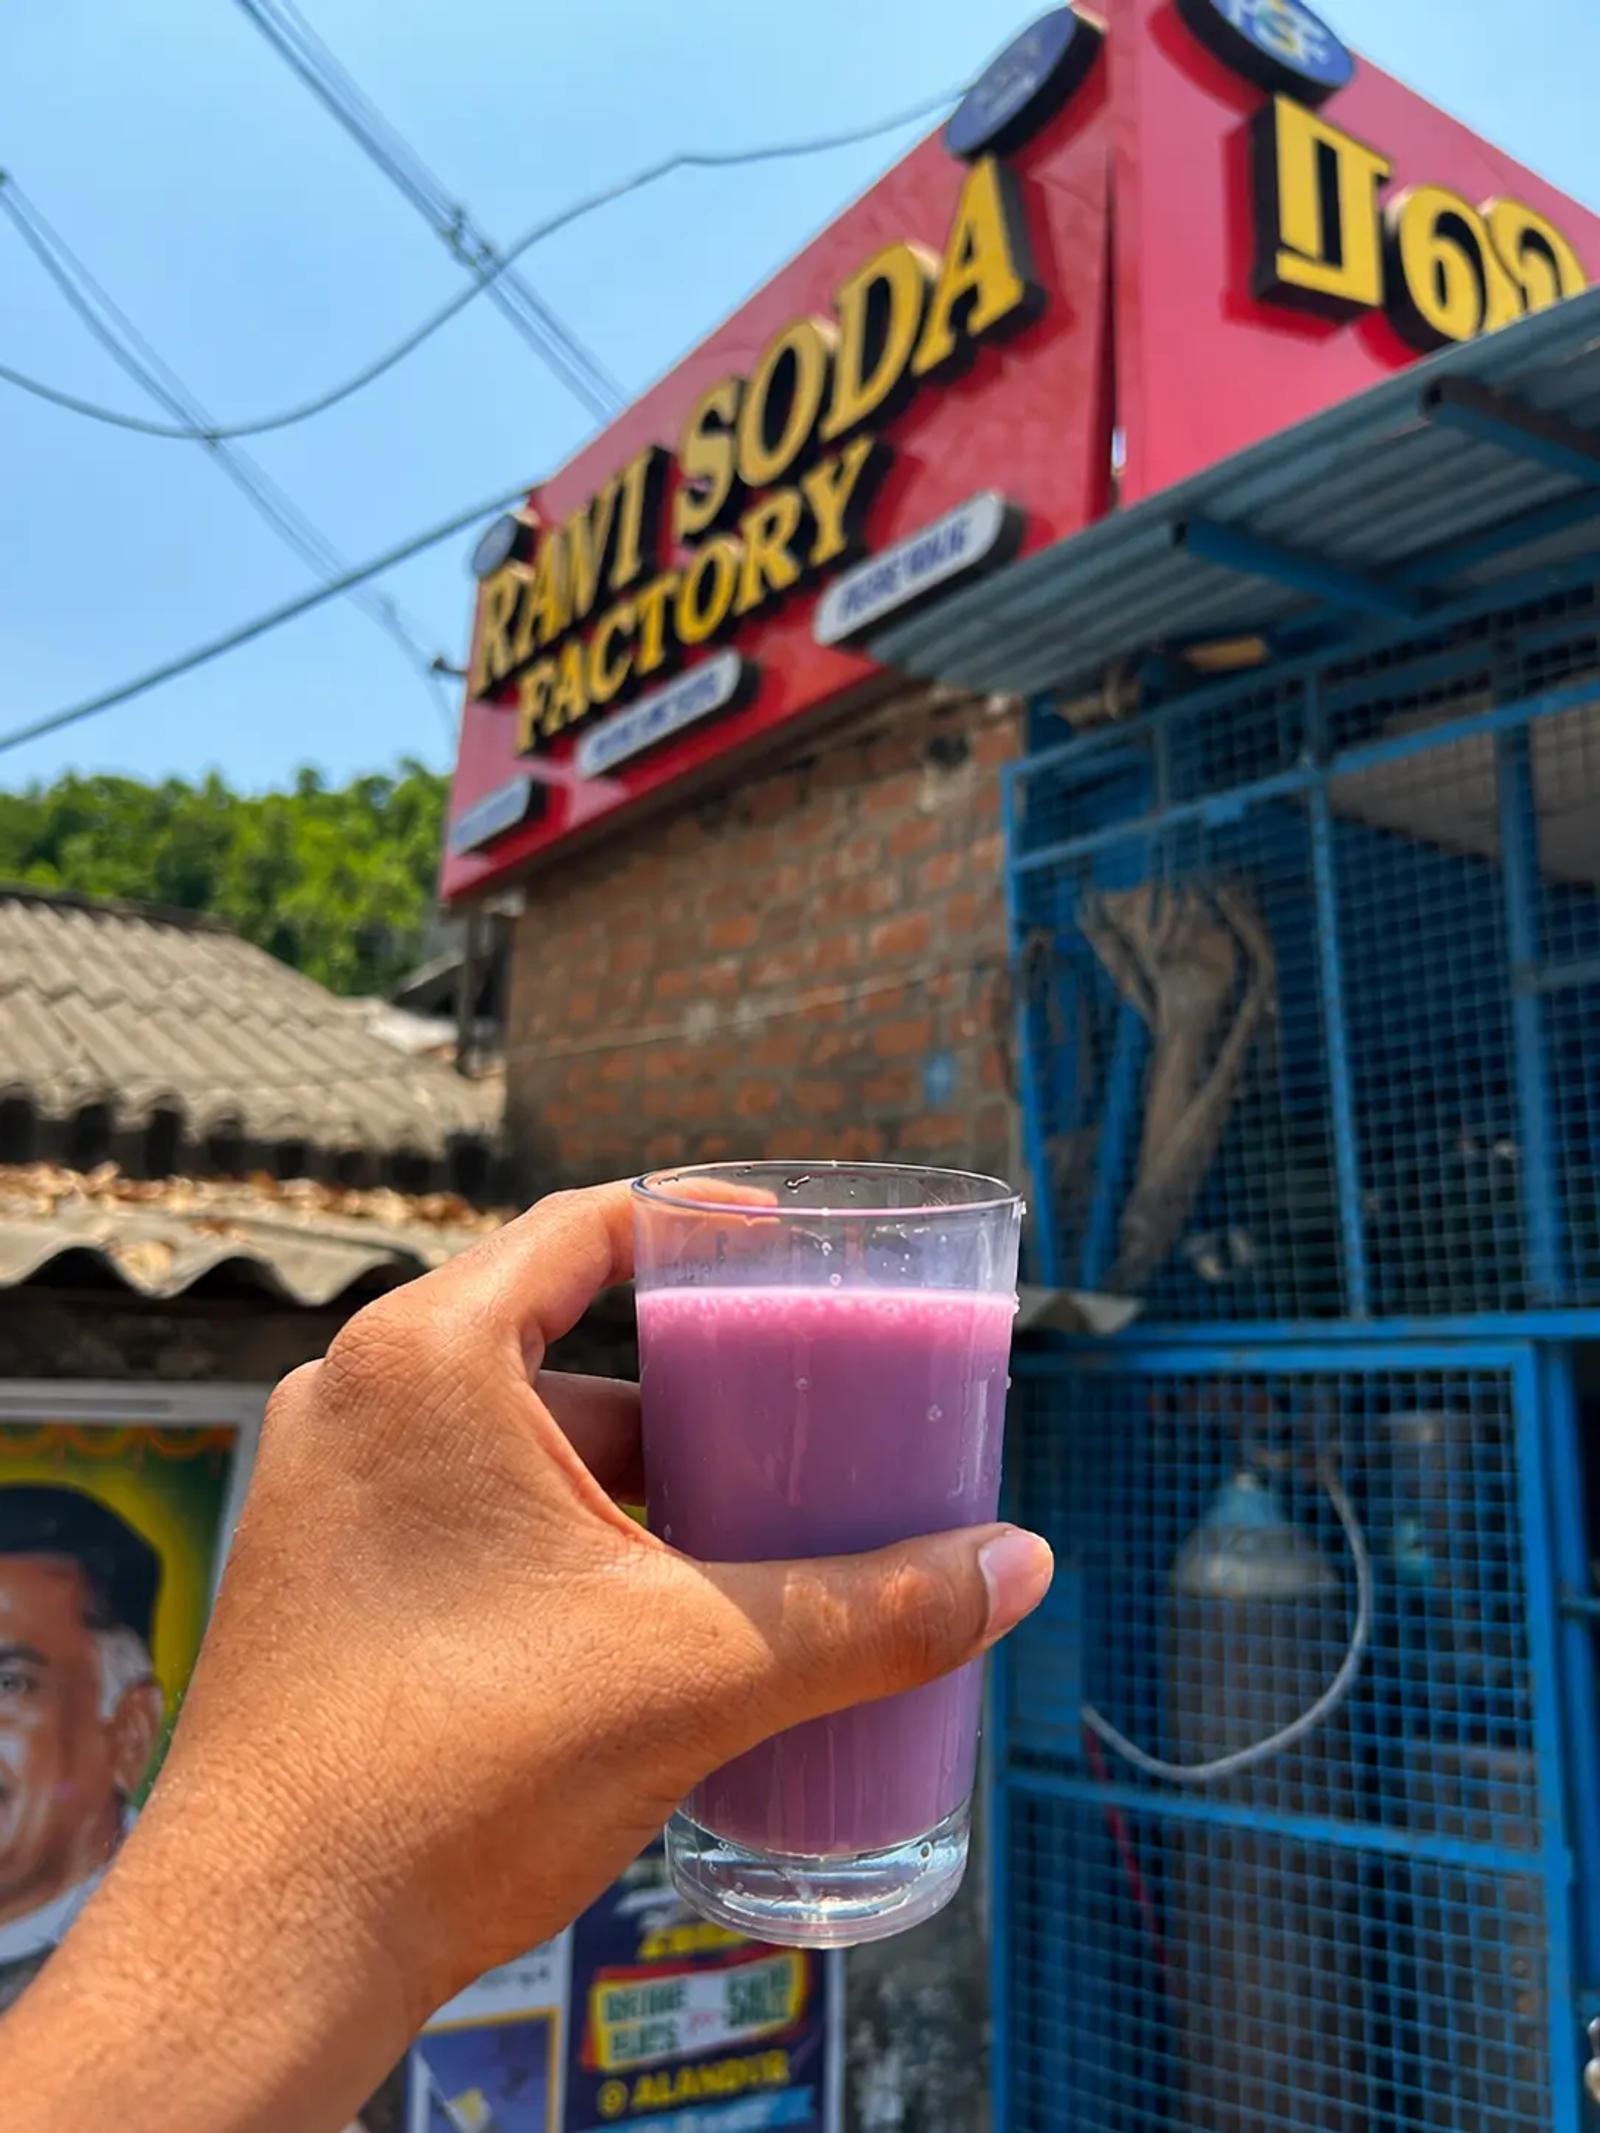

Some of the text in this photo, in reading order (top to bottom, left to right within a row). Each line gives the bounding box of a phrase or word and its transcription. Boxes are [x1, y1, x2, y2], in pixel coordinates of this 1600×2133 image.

[475, 153, 1026, 697] RAVI SODA
[515, 435, 875, 756] FACTORY
